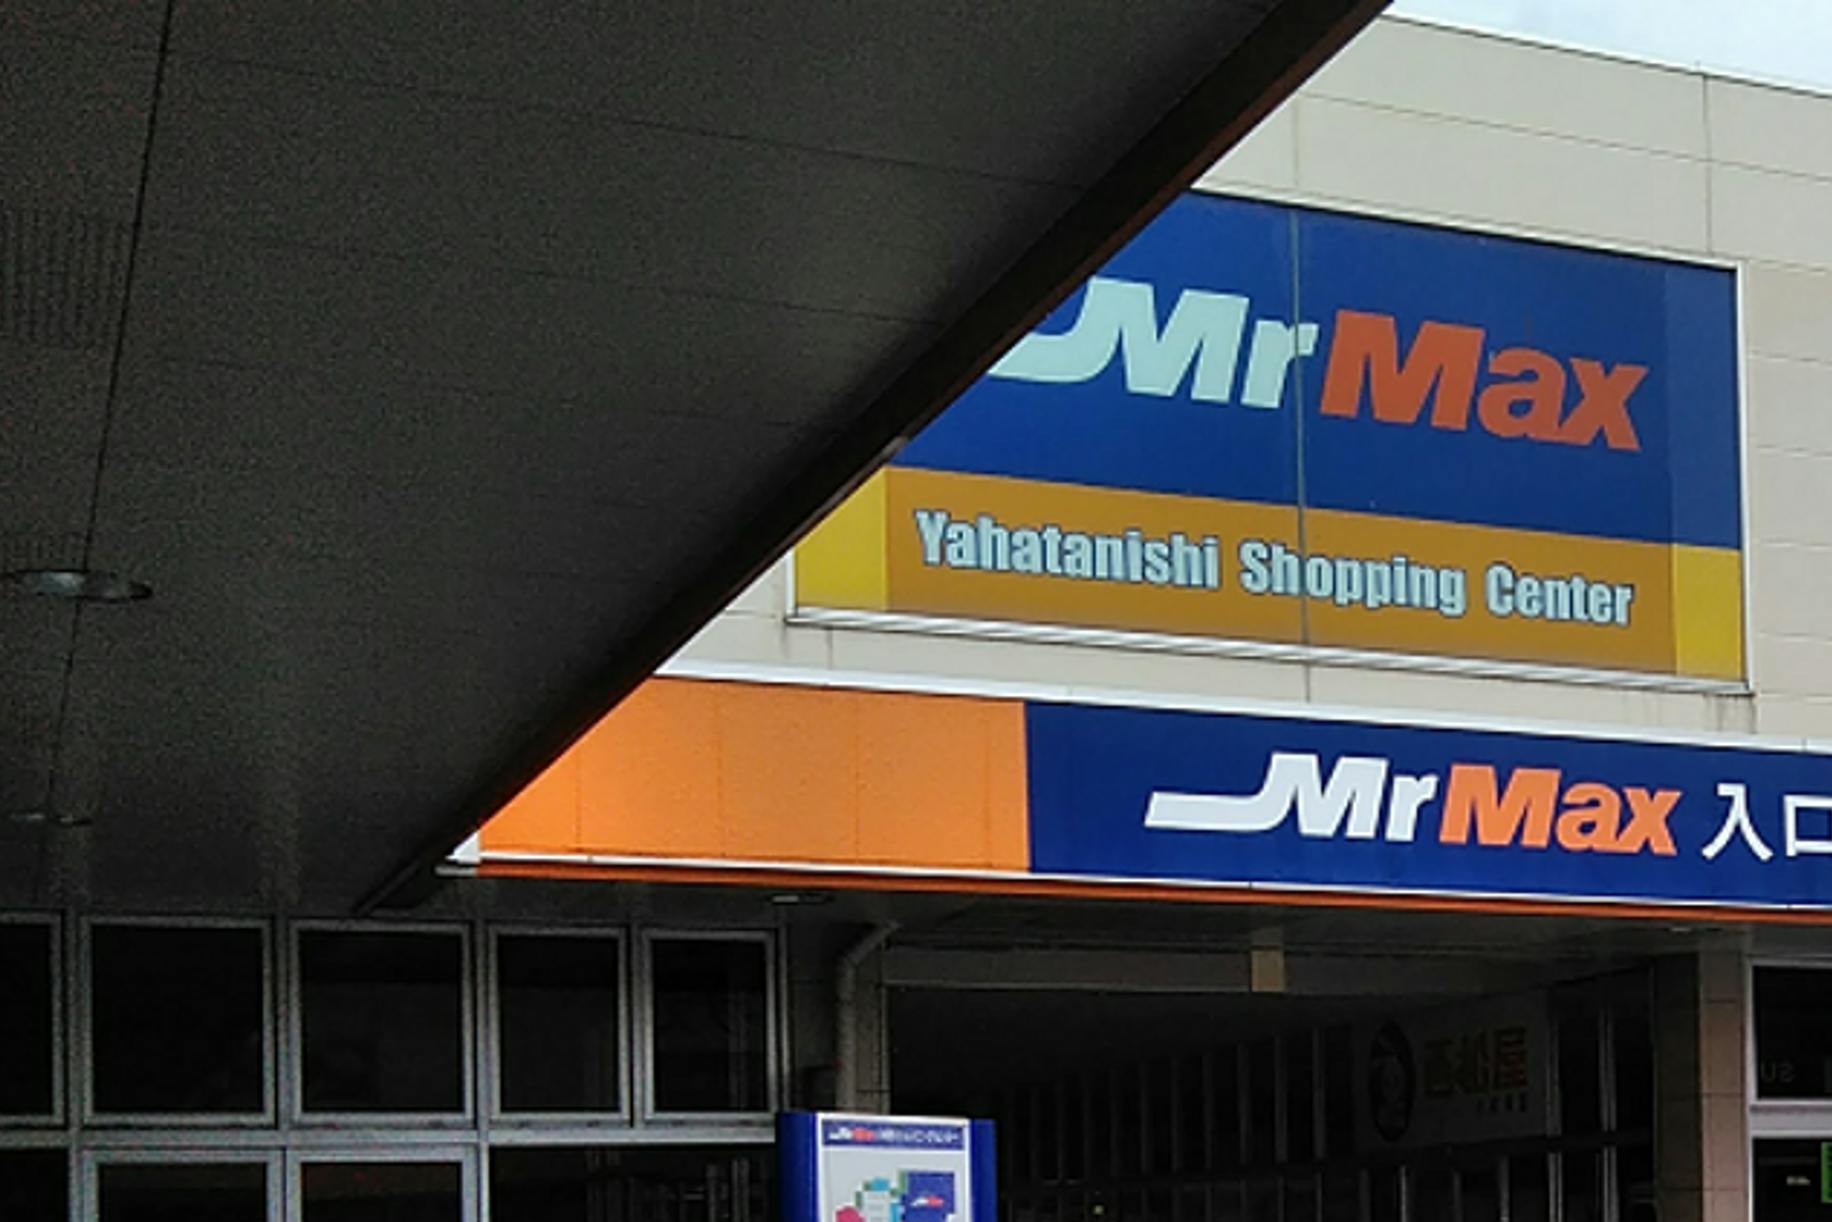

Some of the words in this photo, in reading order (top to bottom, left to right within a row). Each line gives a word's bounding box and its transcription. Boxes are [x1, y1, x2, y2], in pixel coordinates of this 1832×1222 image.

[916, 509, 1219, 591] Yahatanishi
[1240, 540, 1467, 618] Shopping
[1486, 564, 1634, 628] Center
[1144, 751, 1681, 857] MrMax
